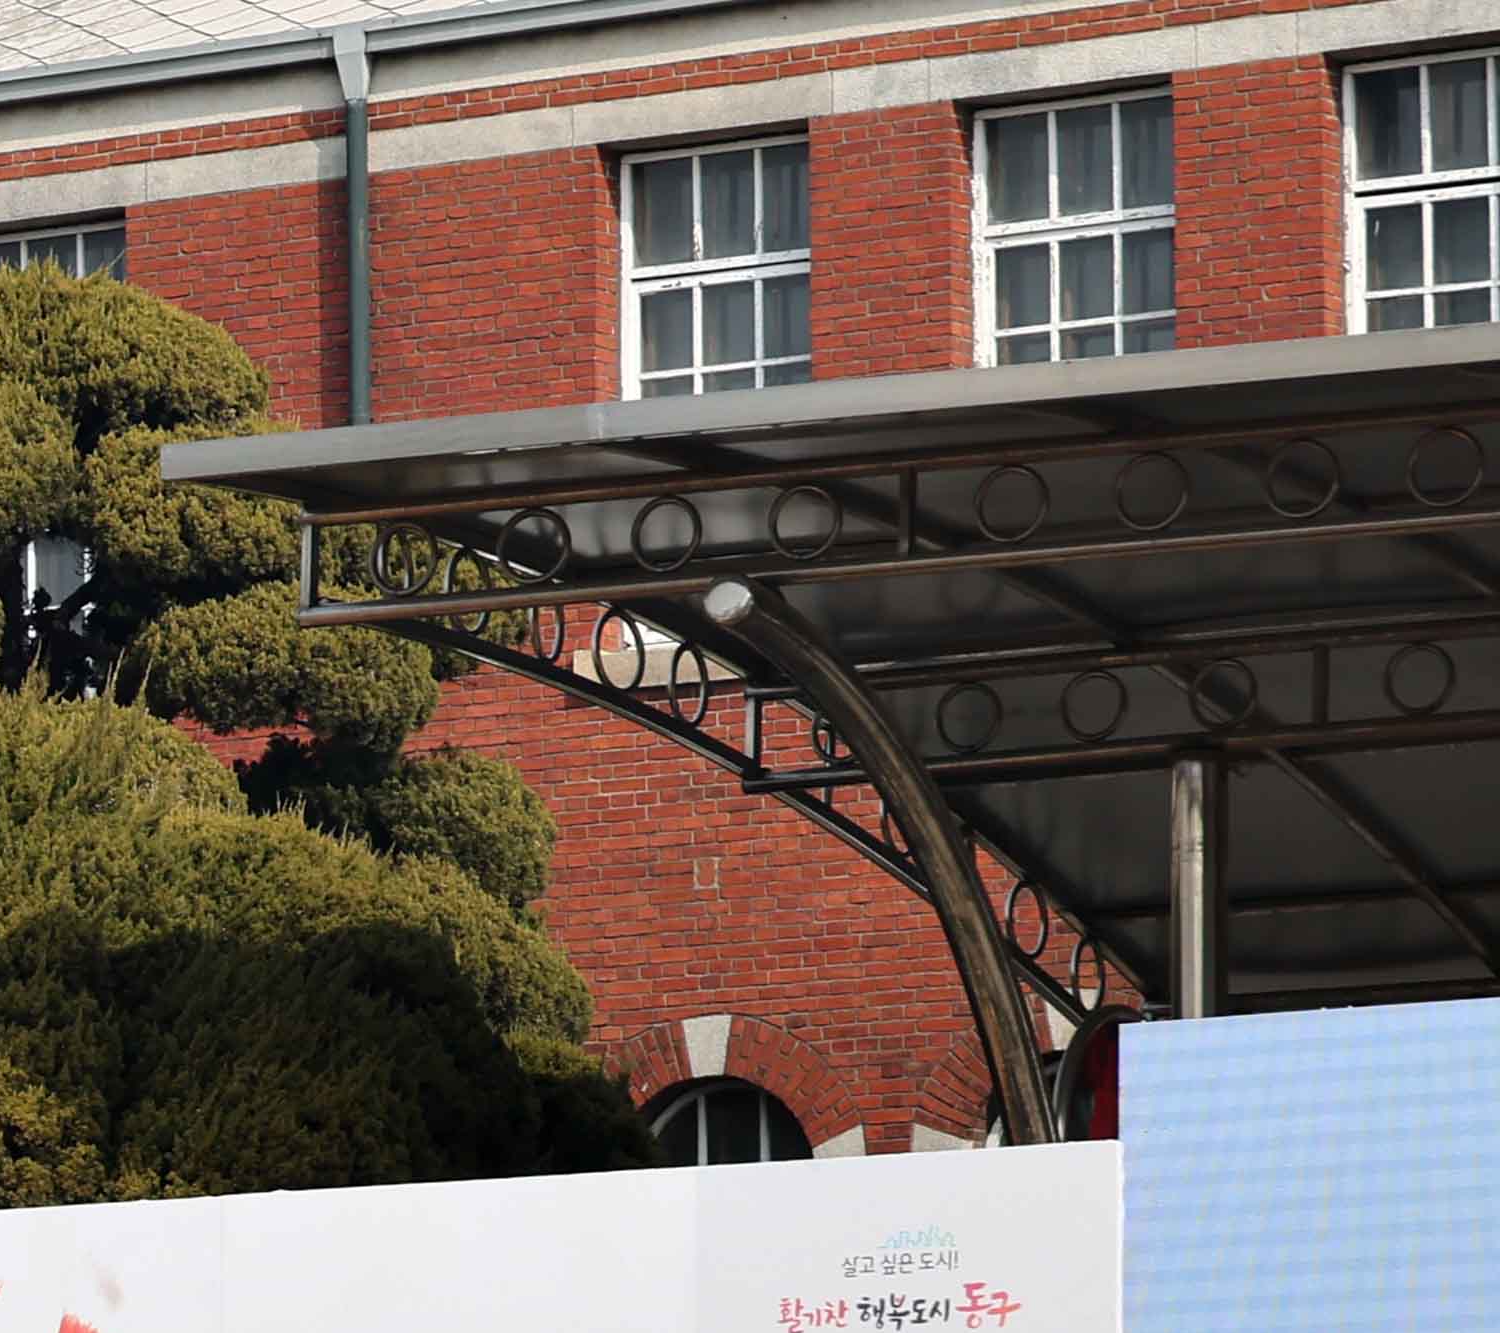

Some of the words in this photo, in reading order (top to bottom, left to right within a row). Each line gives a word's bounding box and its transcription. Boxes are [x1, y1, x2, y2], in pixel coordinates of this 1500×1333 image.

[842, 1255, 876, 1278] 살고
[881, 1251, 914, 1276] 싶은
[918, 1249, 960, 1273] 도시!
[856, 1293, 950, 1331] 행복도시
[956, 1282, 1023, 1329] 동구
